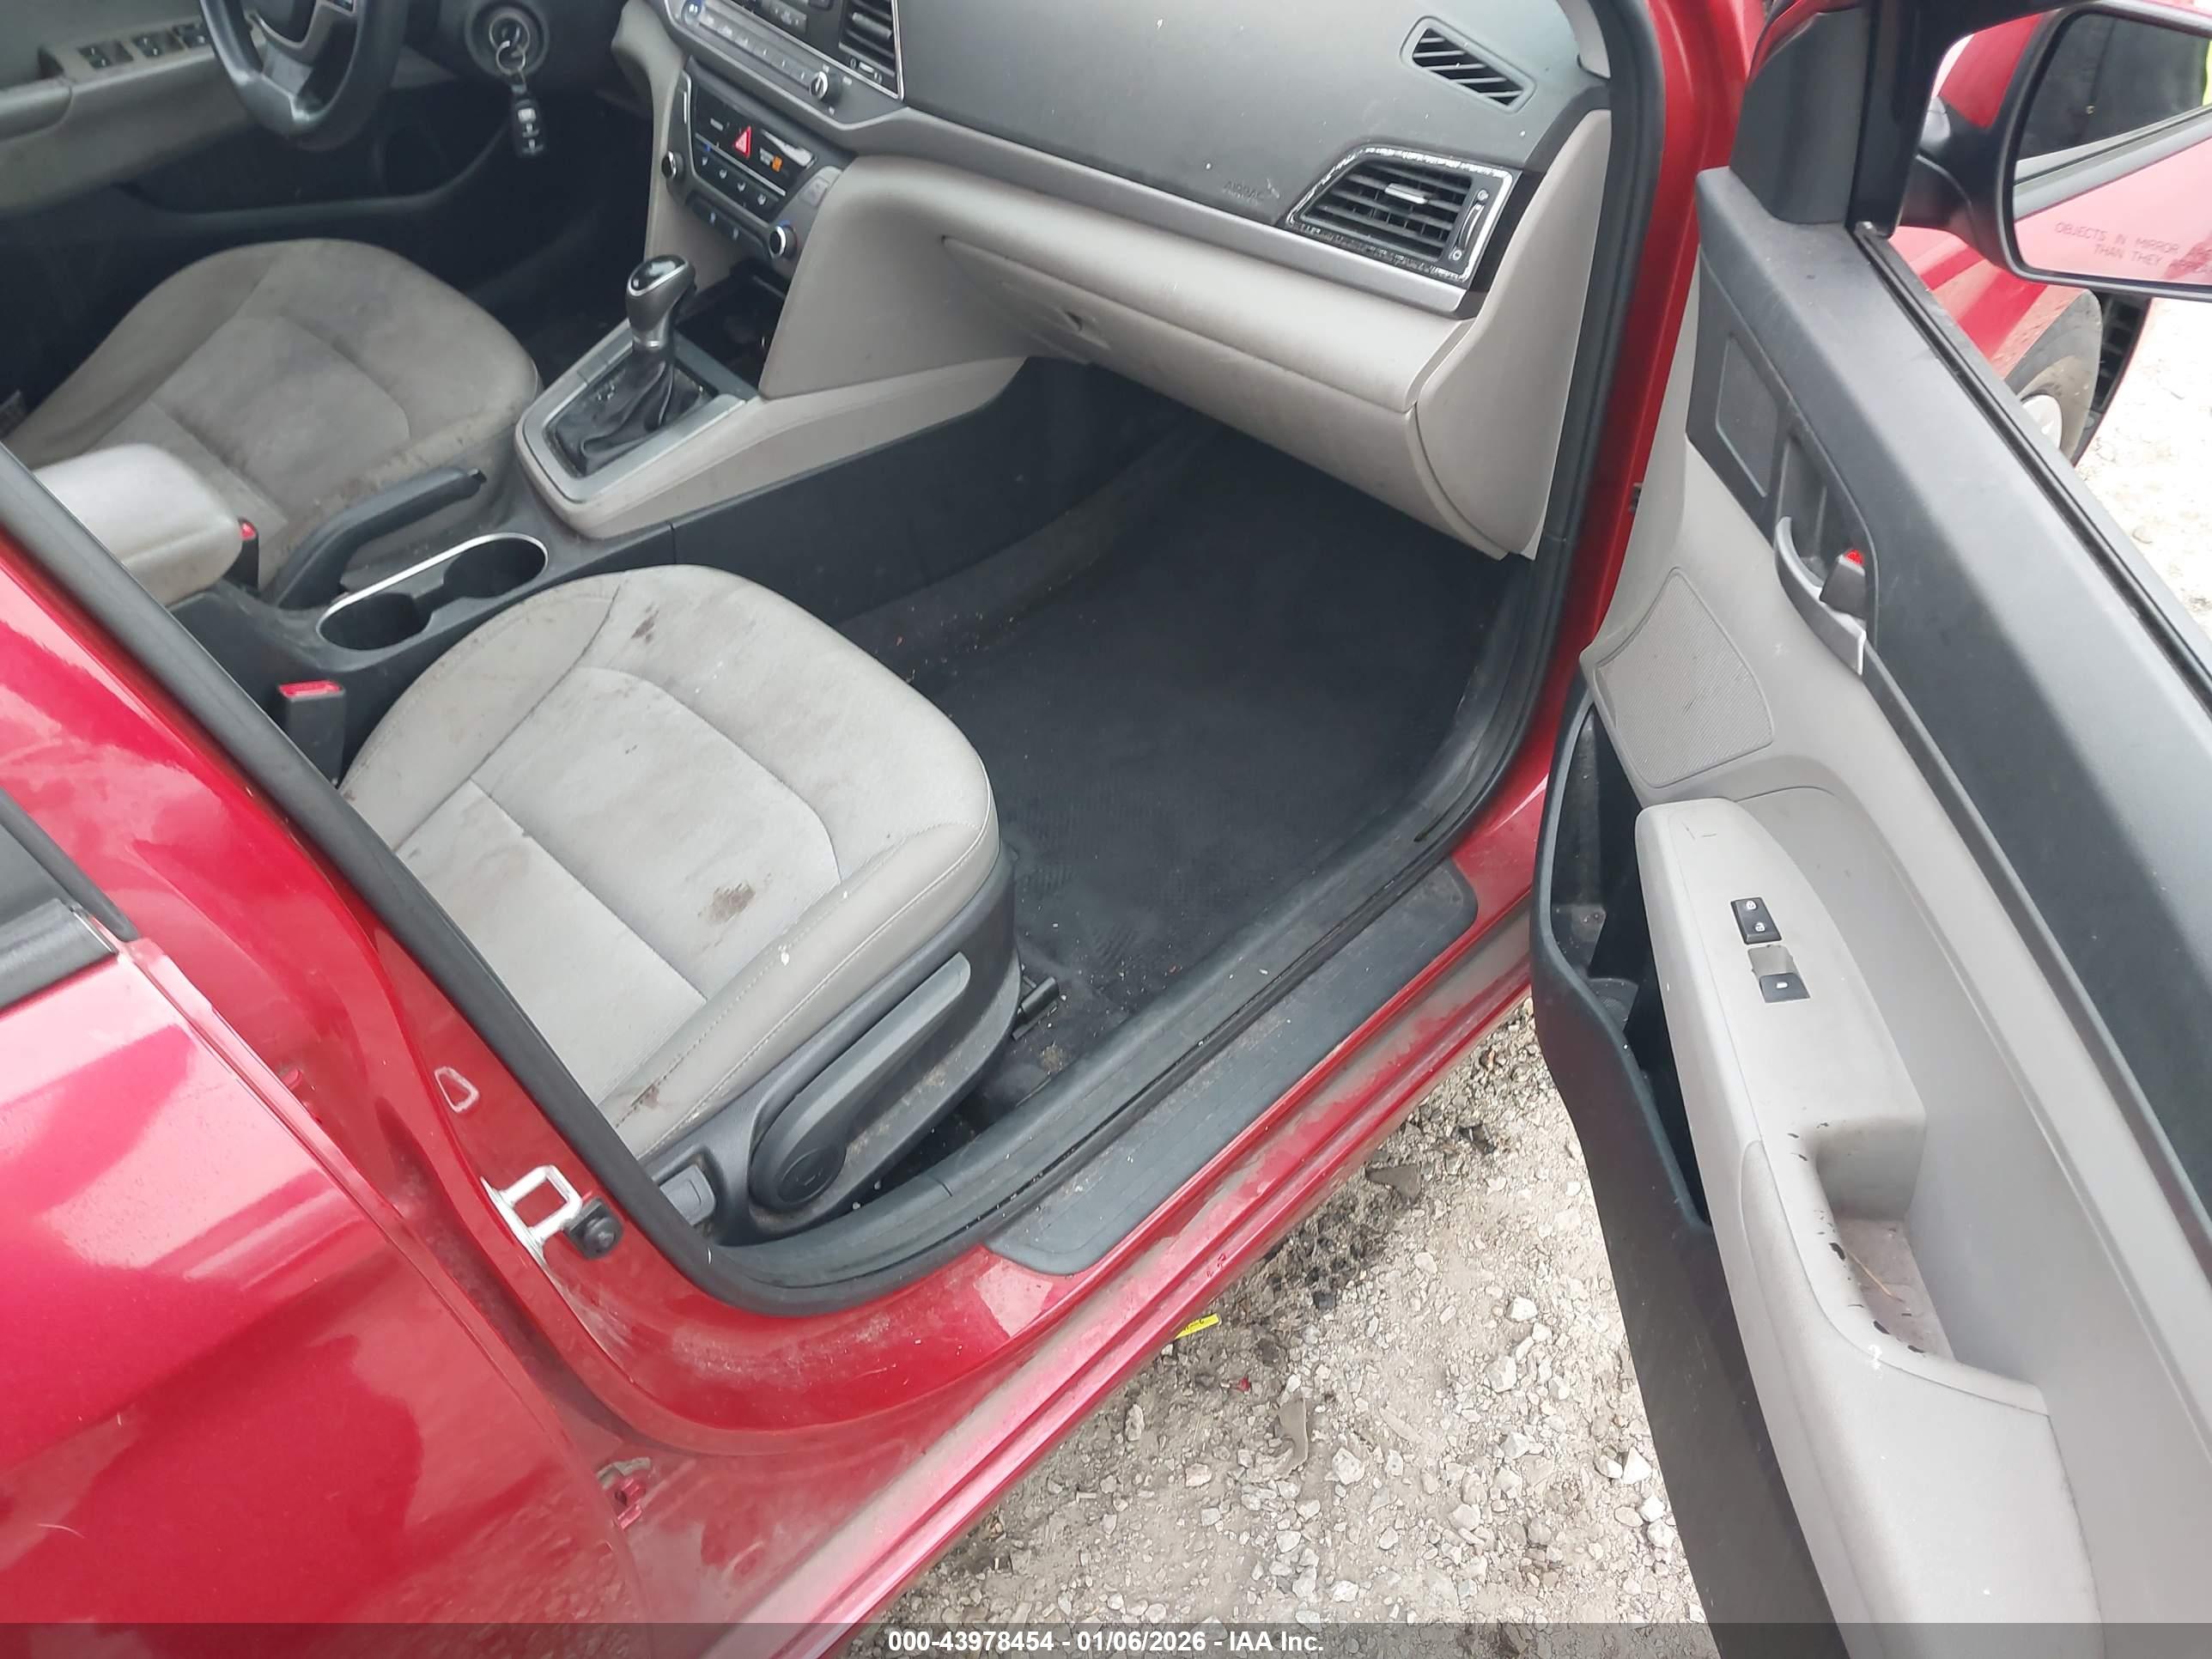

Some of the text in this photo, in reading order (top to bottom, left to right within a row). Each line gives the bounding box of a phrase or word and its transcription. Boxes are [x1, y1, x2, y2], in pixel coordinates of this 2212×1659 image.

[2054, 221, 2108, 241] OBJECTS
[2114, 233, 2129, 246] IN
[2136, 237, 2180, 255] MIRROR
[2094, 243, 2124, 259] THAN
[2130, 250, 2164, 266] THEY
